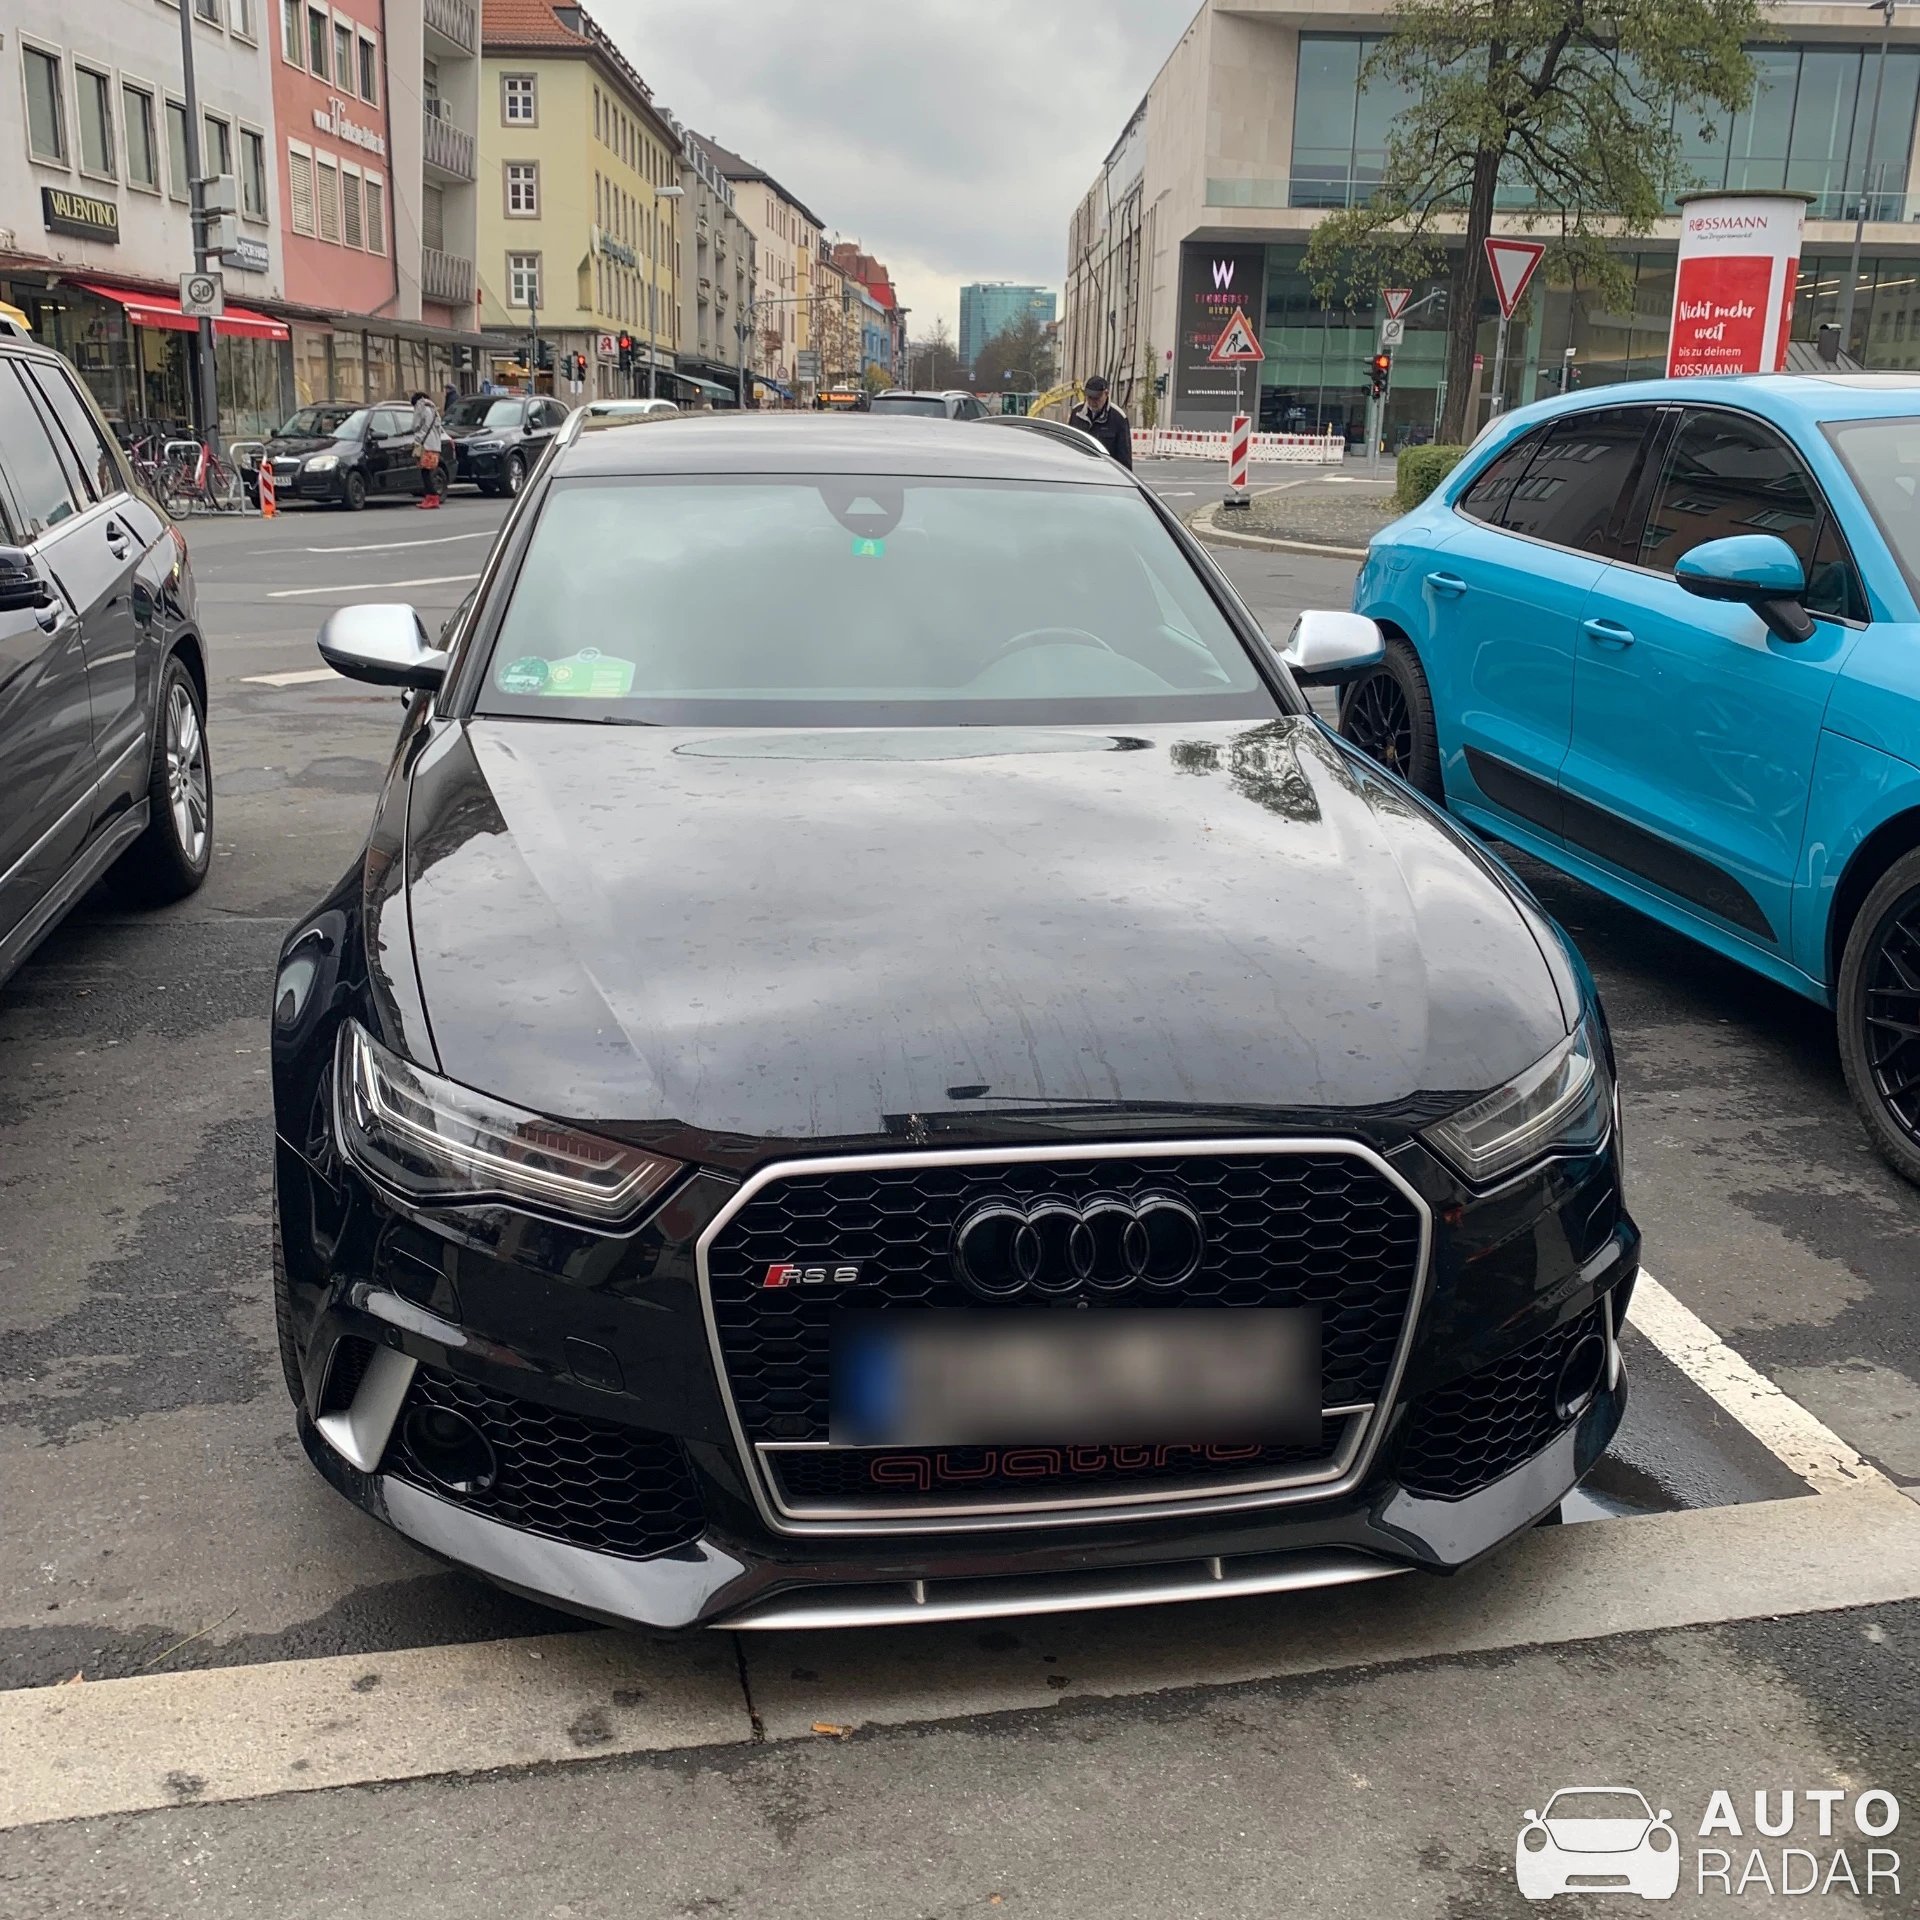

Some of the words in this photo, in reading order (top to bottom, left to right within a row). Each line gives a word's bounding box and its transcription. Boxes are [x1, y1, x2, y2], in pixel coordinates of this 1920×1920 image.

[49, 190, 117, 228] VALENTINO
[1688, 216, 1768, 232] ROSSMANN
[192, 284, 210, 298] 30
[191, 306, 213, 314] ZONE
[1679, 300, 1713, 322] Nicht
[1715, 300, 1756, 319] mehr
[1694, 322, 1727, 341] weit
[1679, 347, 1690, 357] bis
[1691, 349, 1702, 357] zu
[1704, 346, 1741, 357] deinem
[1674, 364, 1744, 377] ROSSMANN
[778, 1268, 827, 1285] RS
[834, 1267, 859, 1283] 6
